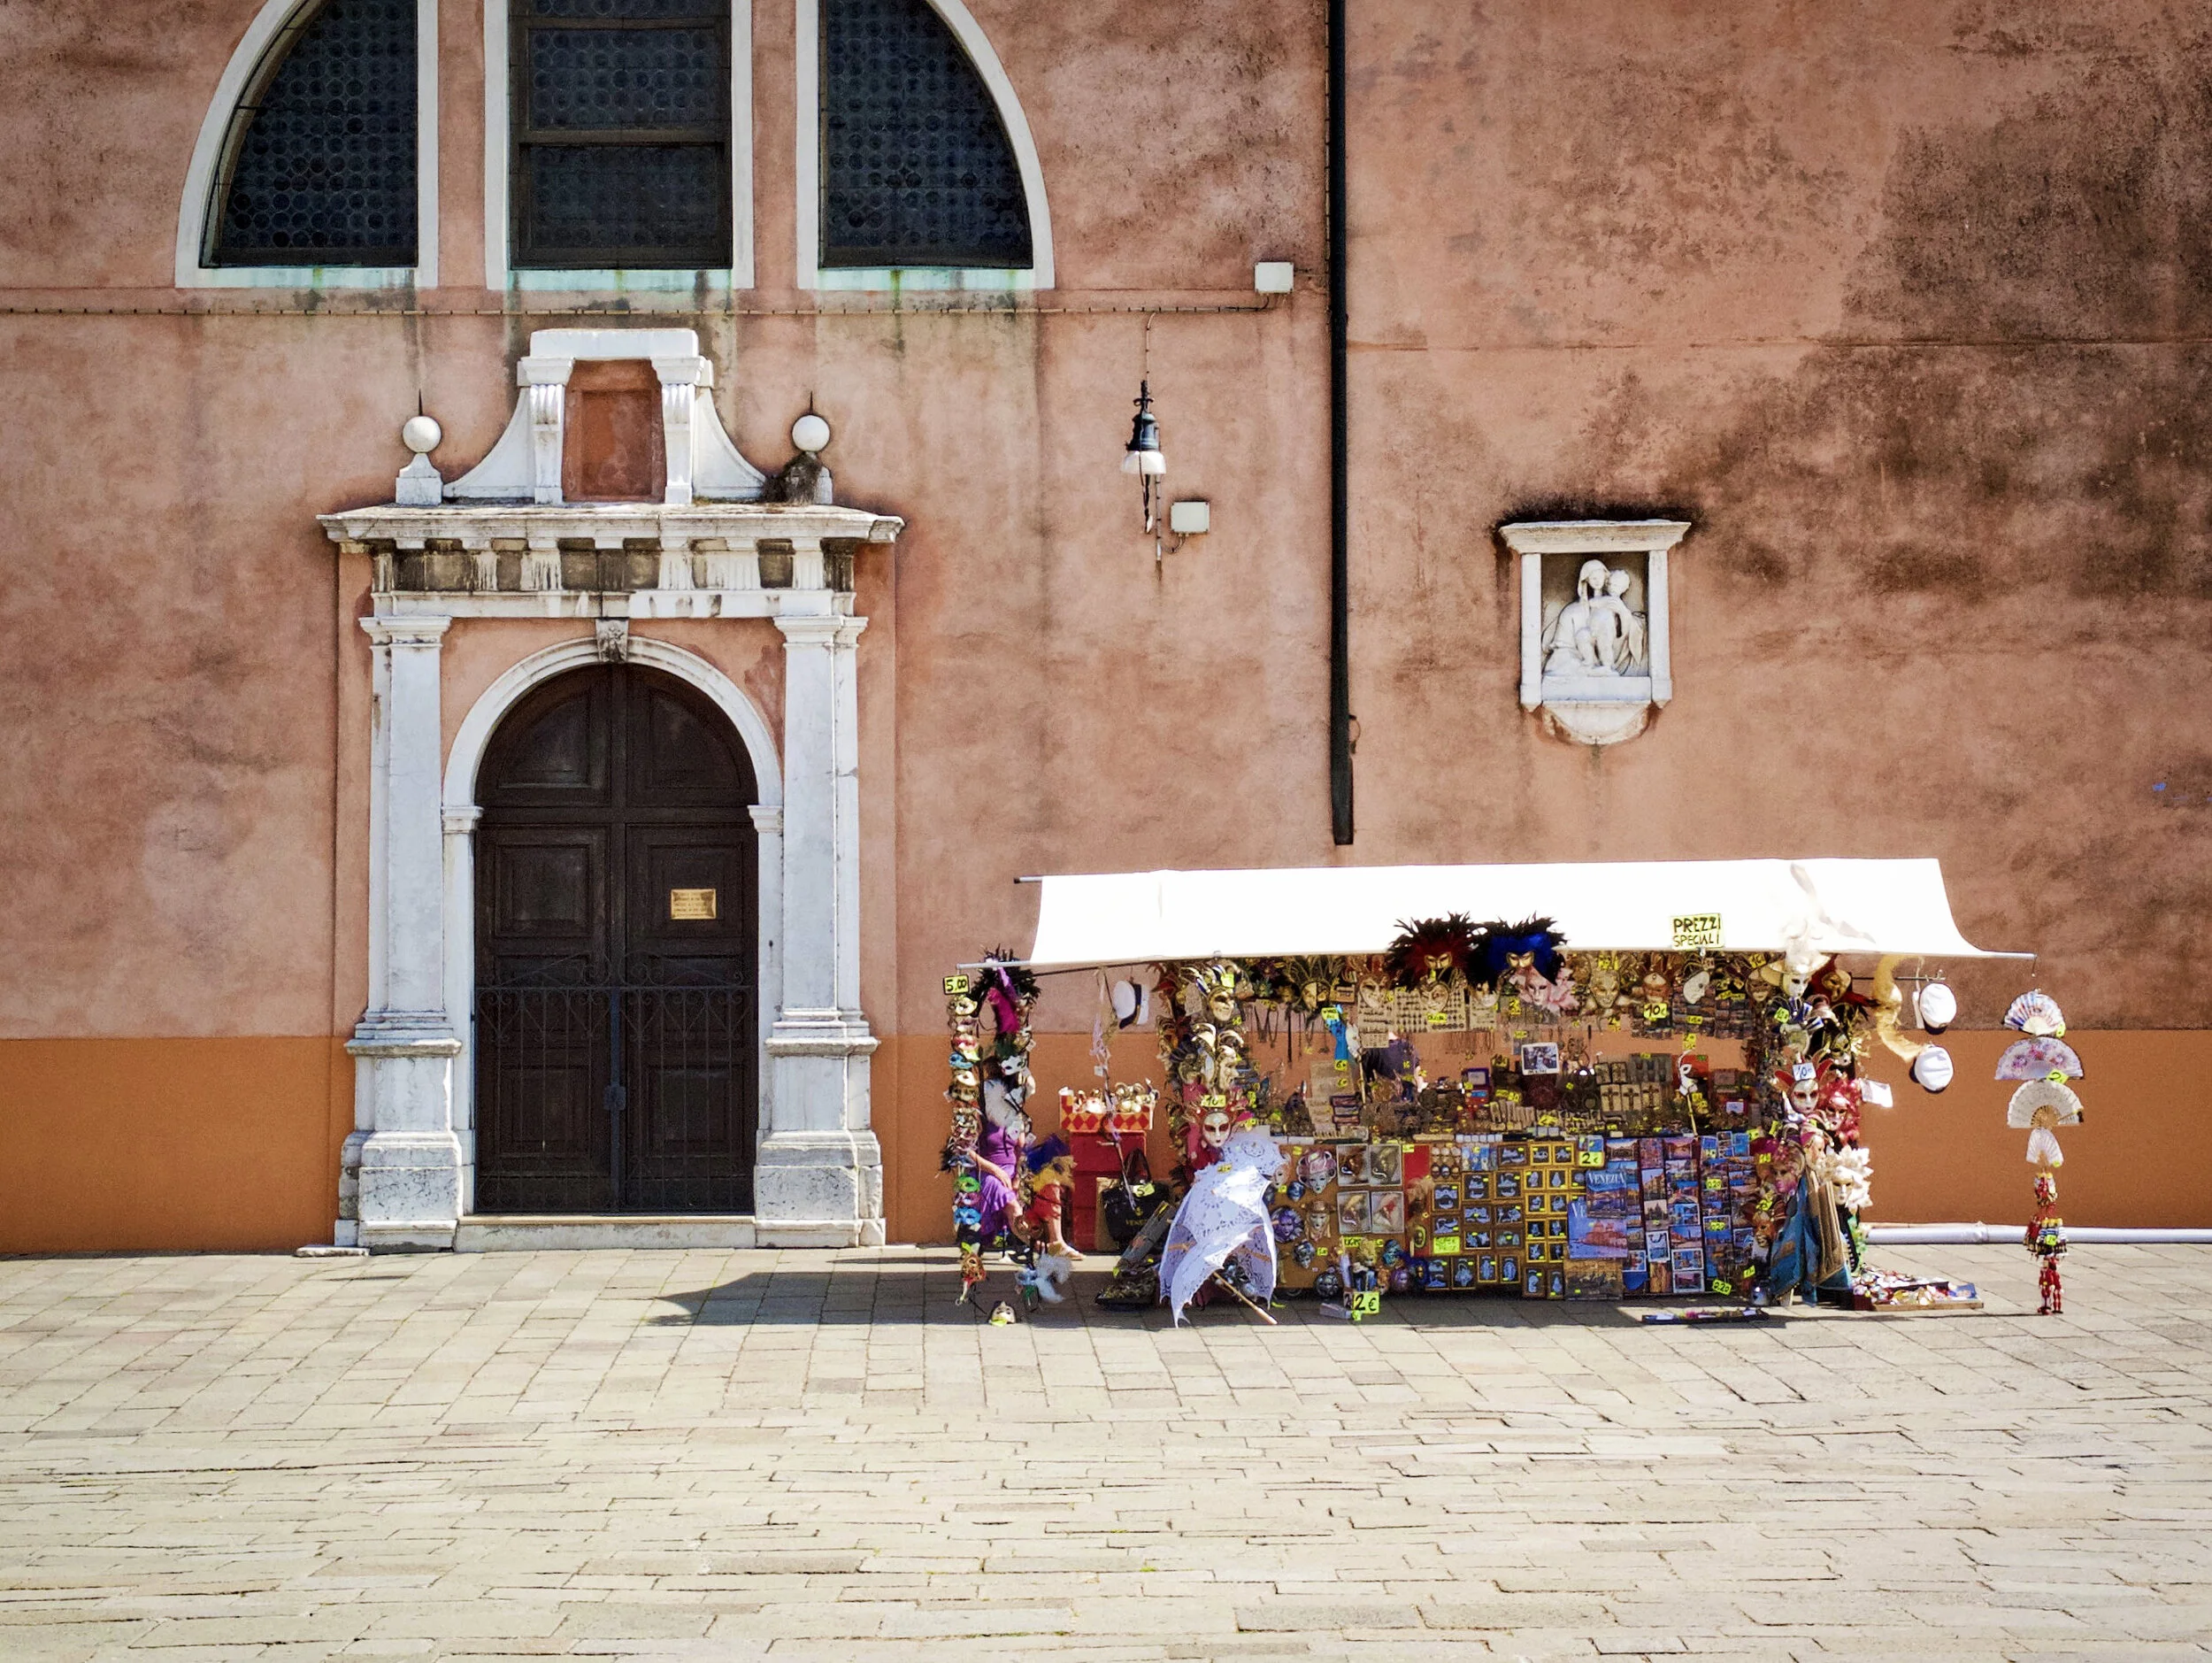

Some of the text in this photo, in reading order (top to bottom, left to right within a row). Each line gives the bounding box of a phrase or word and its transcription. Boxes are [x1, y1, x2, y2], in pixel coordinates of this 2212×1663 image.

[1673, 917, 1721, 933] PREZZI
[1672, 933, 1719, 947] SPECIALI
[1588, 1172, 1624, 1183] VENEZIA
